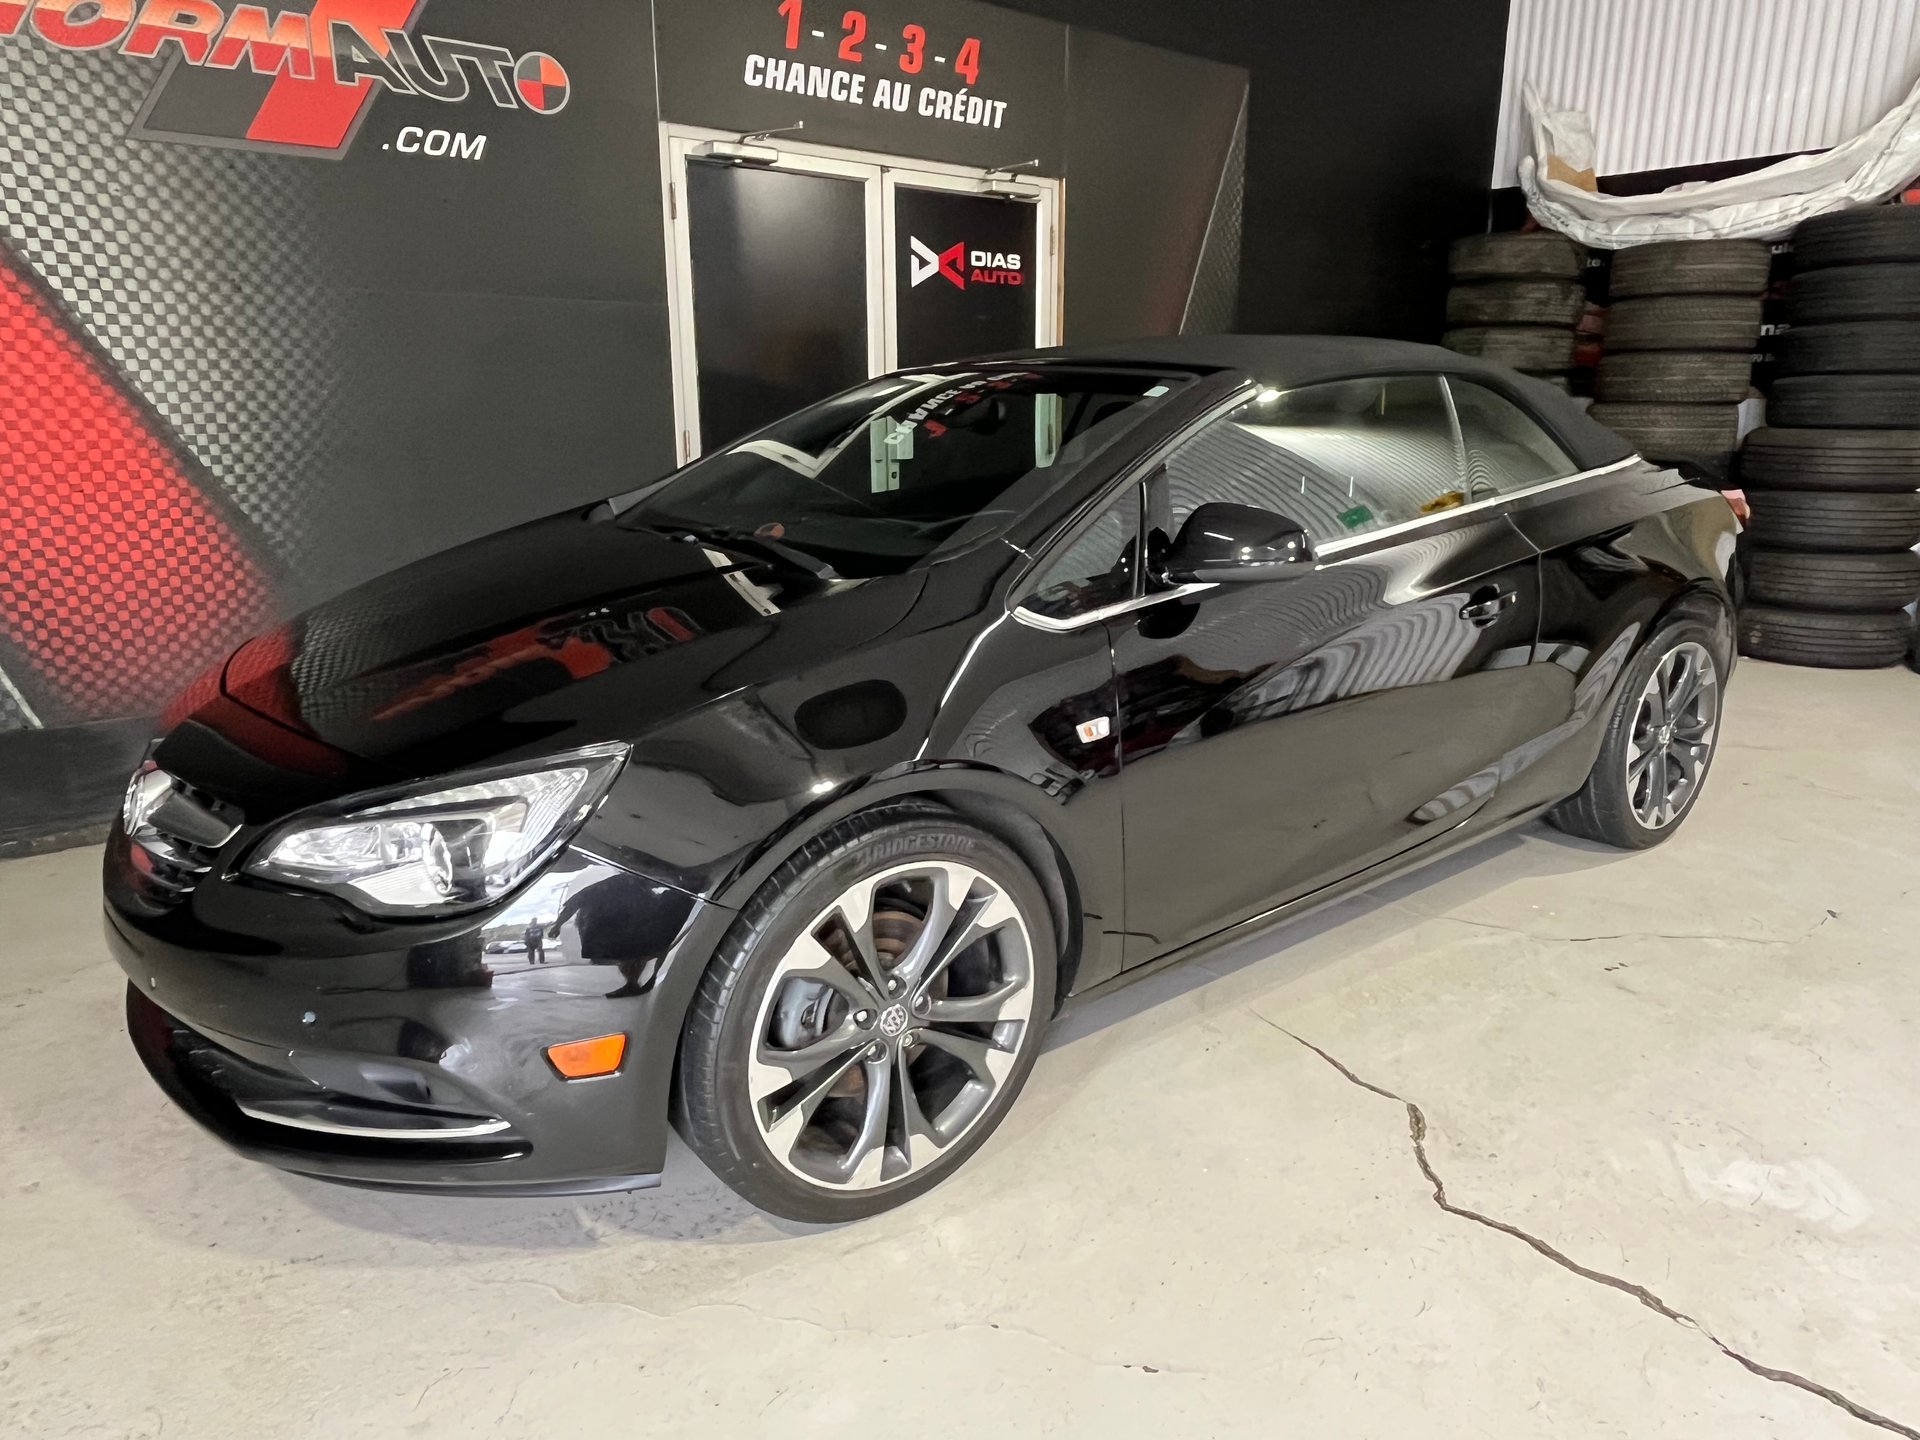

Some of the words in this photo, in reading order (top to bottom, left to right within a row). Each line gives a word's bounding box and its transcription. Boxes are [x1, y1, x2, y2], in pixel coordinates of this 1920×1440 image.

[743, 53, 866, 105] CHANCE
[872, 78, 912, 113] AU
[917, 87, 1008, 130] CRÉDIT
[382, 126, 487, 161] .COM
[970, 250, 1021, 270] DIAS
[970, 268, 1022, 286] AUTO
